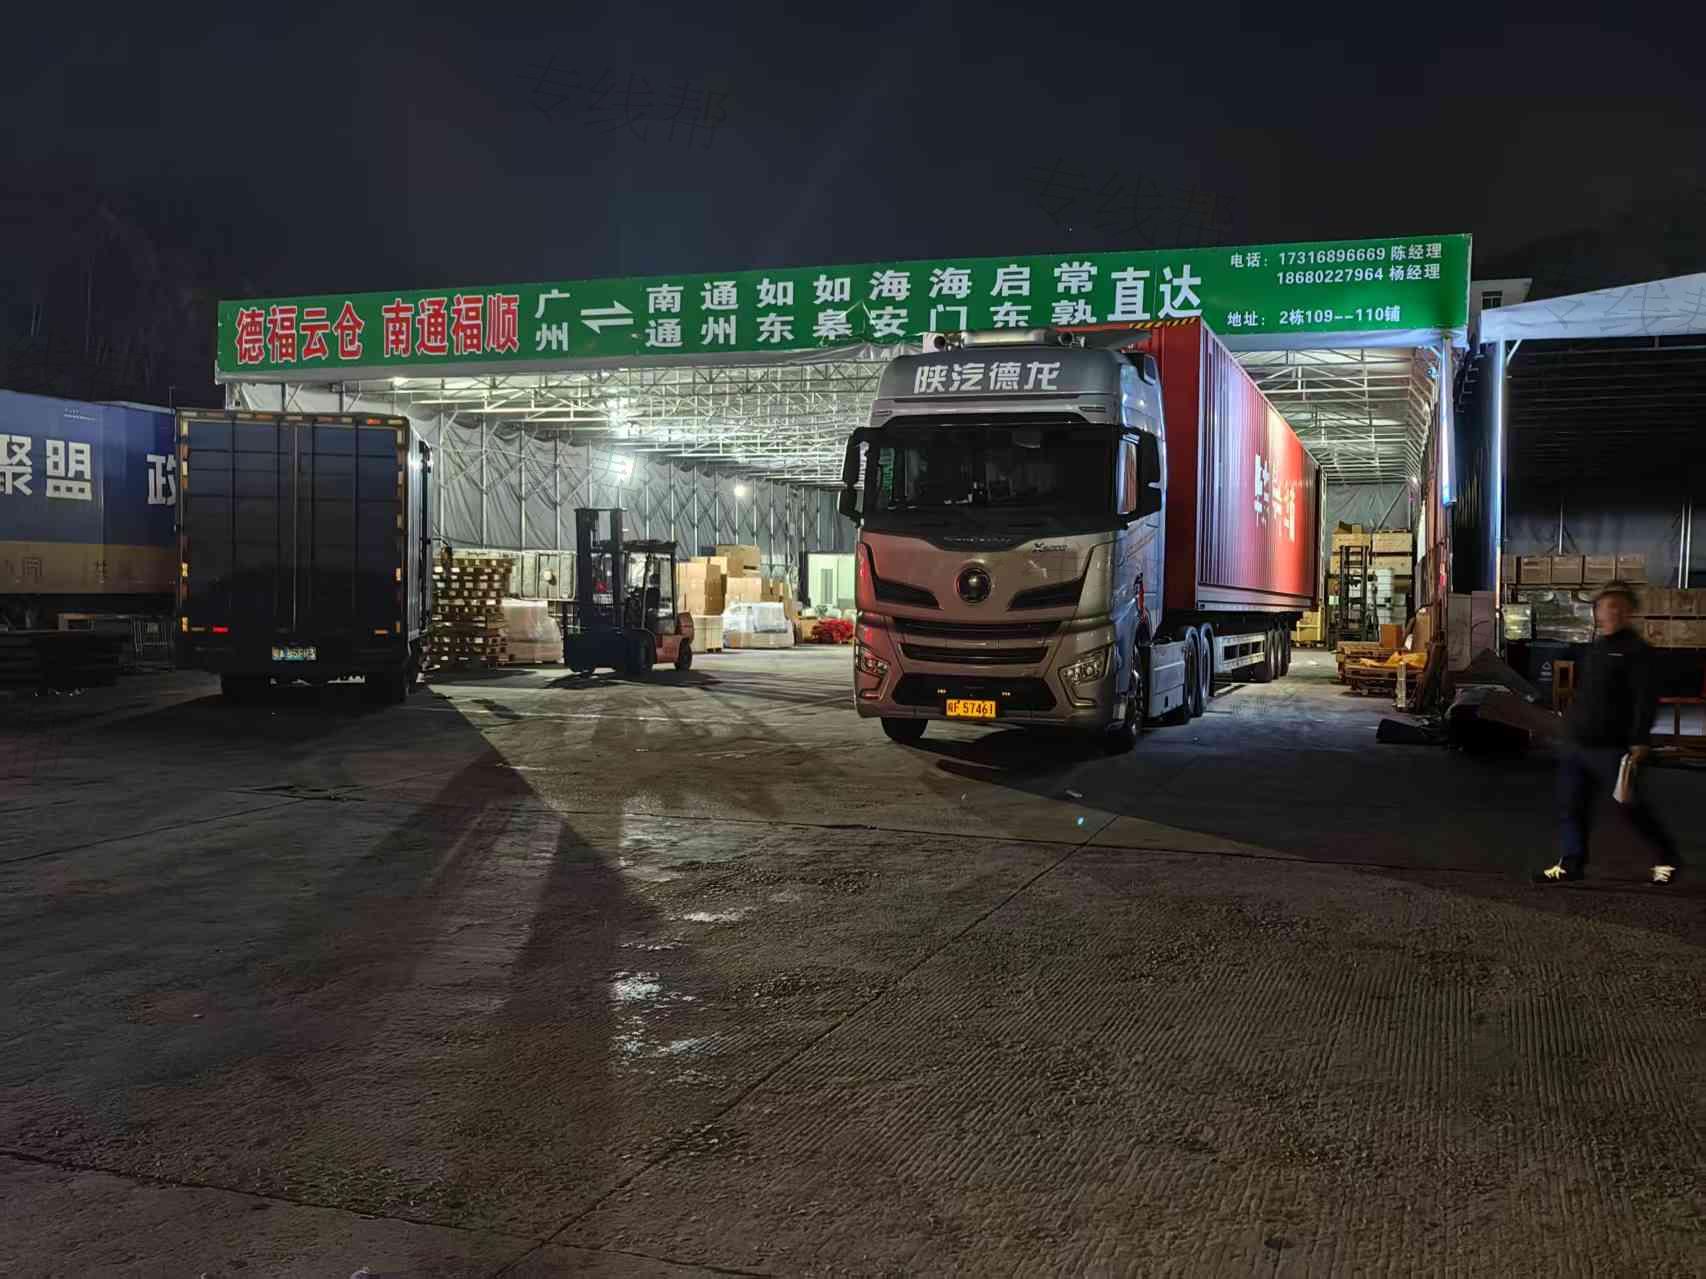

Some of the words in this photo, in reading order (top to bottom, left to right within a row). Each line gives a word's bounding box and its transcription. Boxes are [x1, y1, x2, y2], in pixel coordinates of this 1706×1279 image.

[1279, 247, 1386, 266] 17316896669
[1390, 243, 1442, 261] 陈经理
[1276, 267, 1384, 285] 18680227964
[1388, 263, 1440, 281] 杨经理
[235, 300, 365, 365] 德福云仓
[382, 293, 520, 358] 南通福顺
[1106, 263, 1203, 321] 直达
[913, 360, 1061, 394] 陕汽德龙
